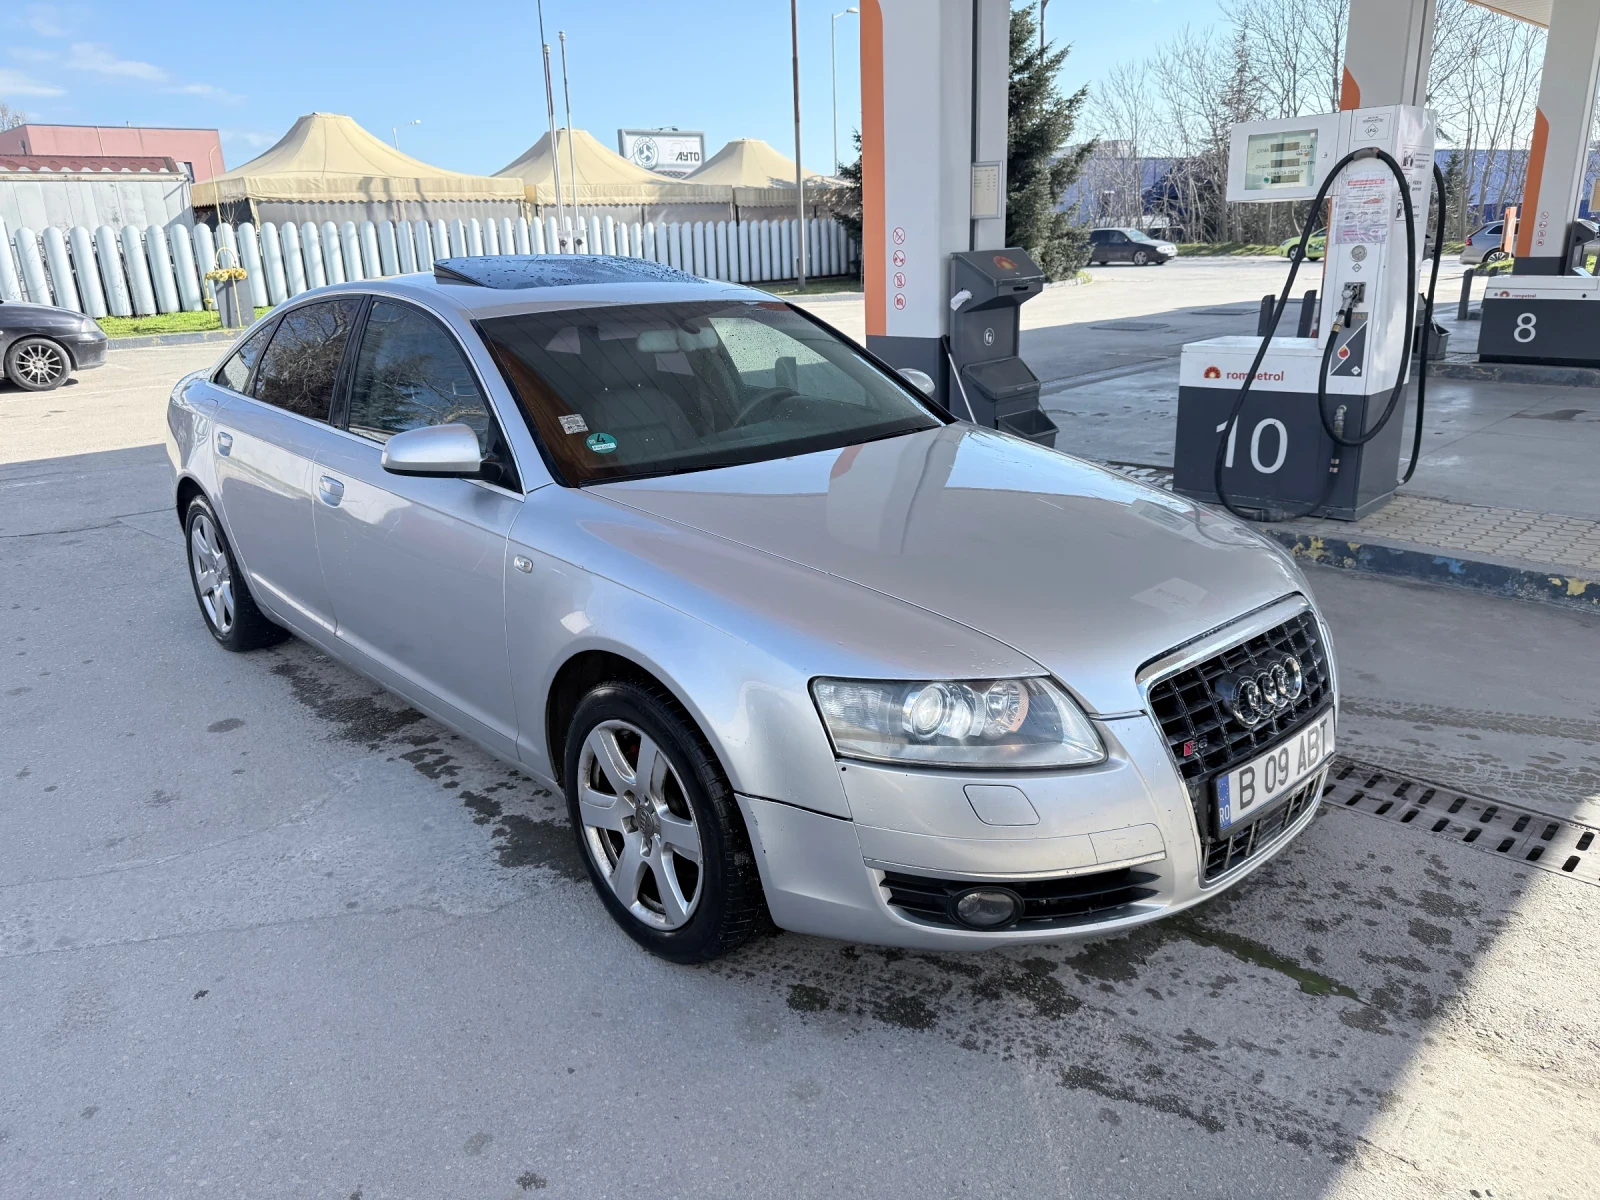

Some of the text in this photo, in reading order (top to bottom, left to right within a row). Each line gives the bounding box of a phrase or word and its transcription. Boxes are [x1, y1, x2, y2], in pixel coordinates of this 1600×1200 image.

[1513, 312, 1537, 343] 8
[1226, 370, 1285, 382] rometrol
[596, 433, 606, 443] 4
[1216, 414, 1288, 474] 10
[1239, 718, 1328, 811] B 09 ABT
[1219, 804, 1230, 822] RO
